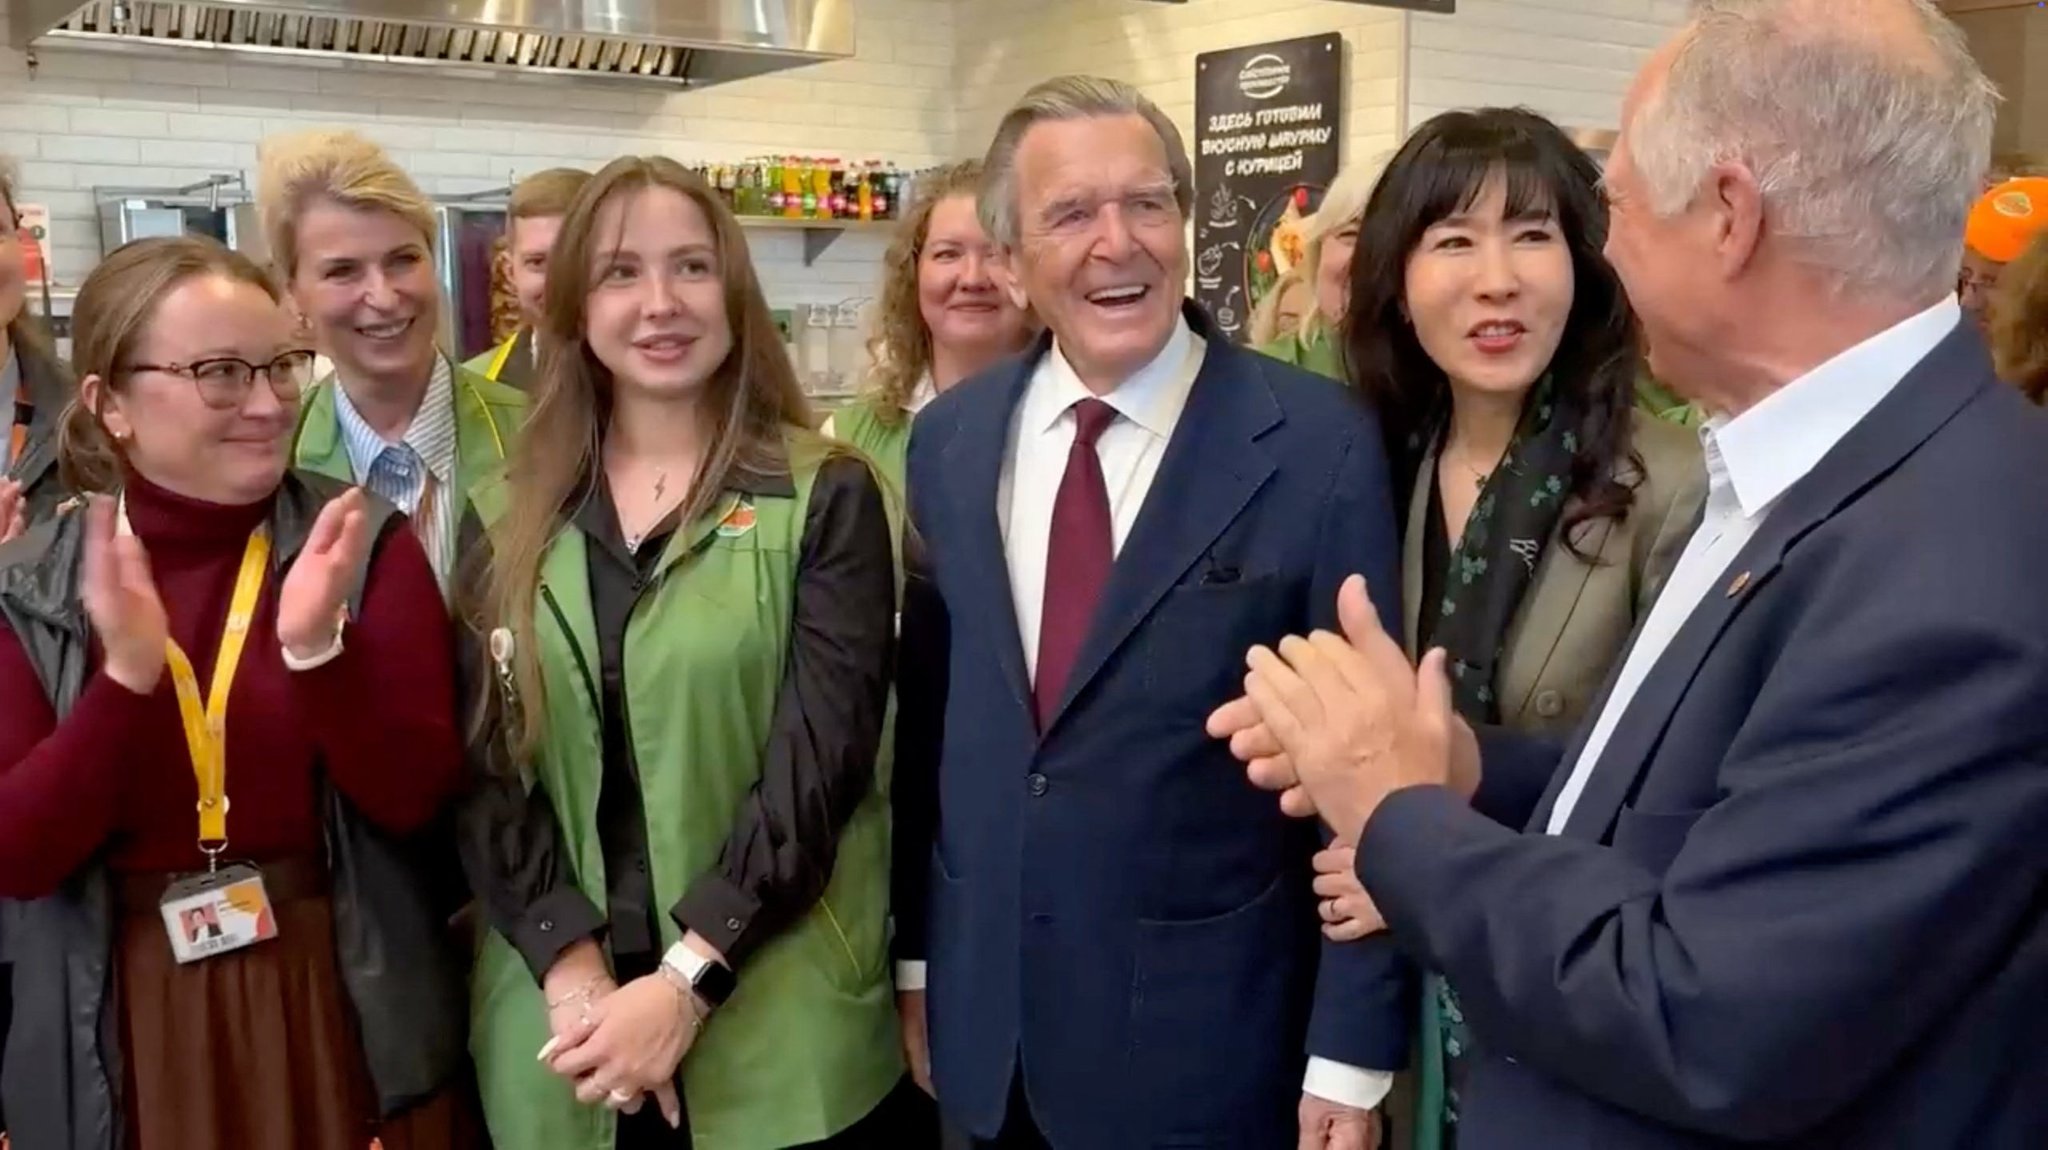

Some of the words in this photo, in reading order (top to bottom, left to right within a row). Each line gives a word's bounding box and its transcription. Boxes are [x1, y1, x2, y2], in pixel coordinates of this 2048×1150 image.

[1208, 111, 1253, 132] ЗДЕСЬ
[1256, 102, 1322, 126] ГОТОВИМ
[1201, 133, 1267, 155] ВКУСНУЮ
[1225, 160, 1235, 176] С
[1237, 149, 1303, 176] КУРИЦЕЙ
